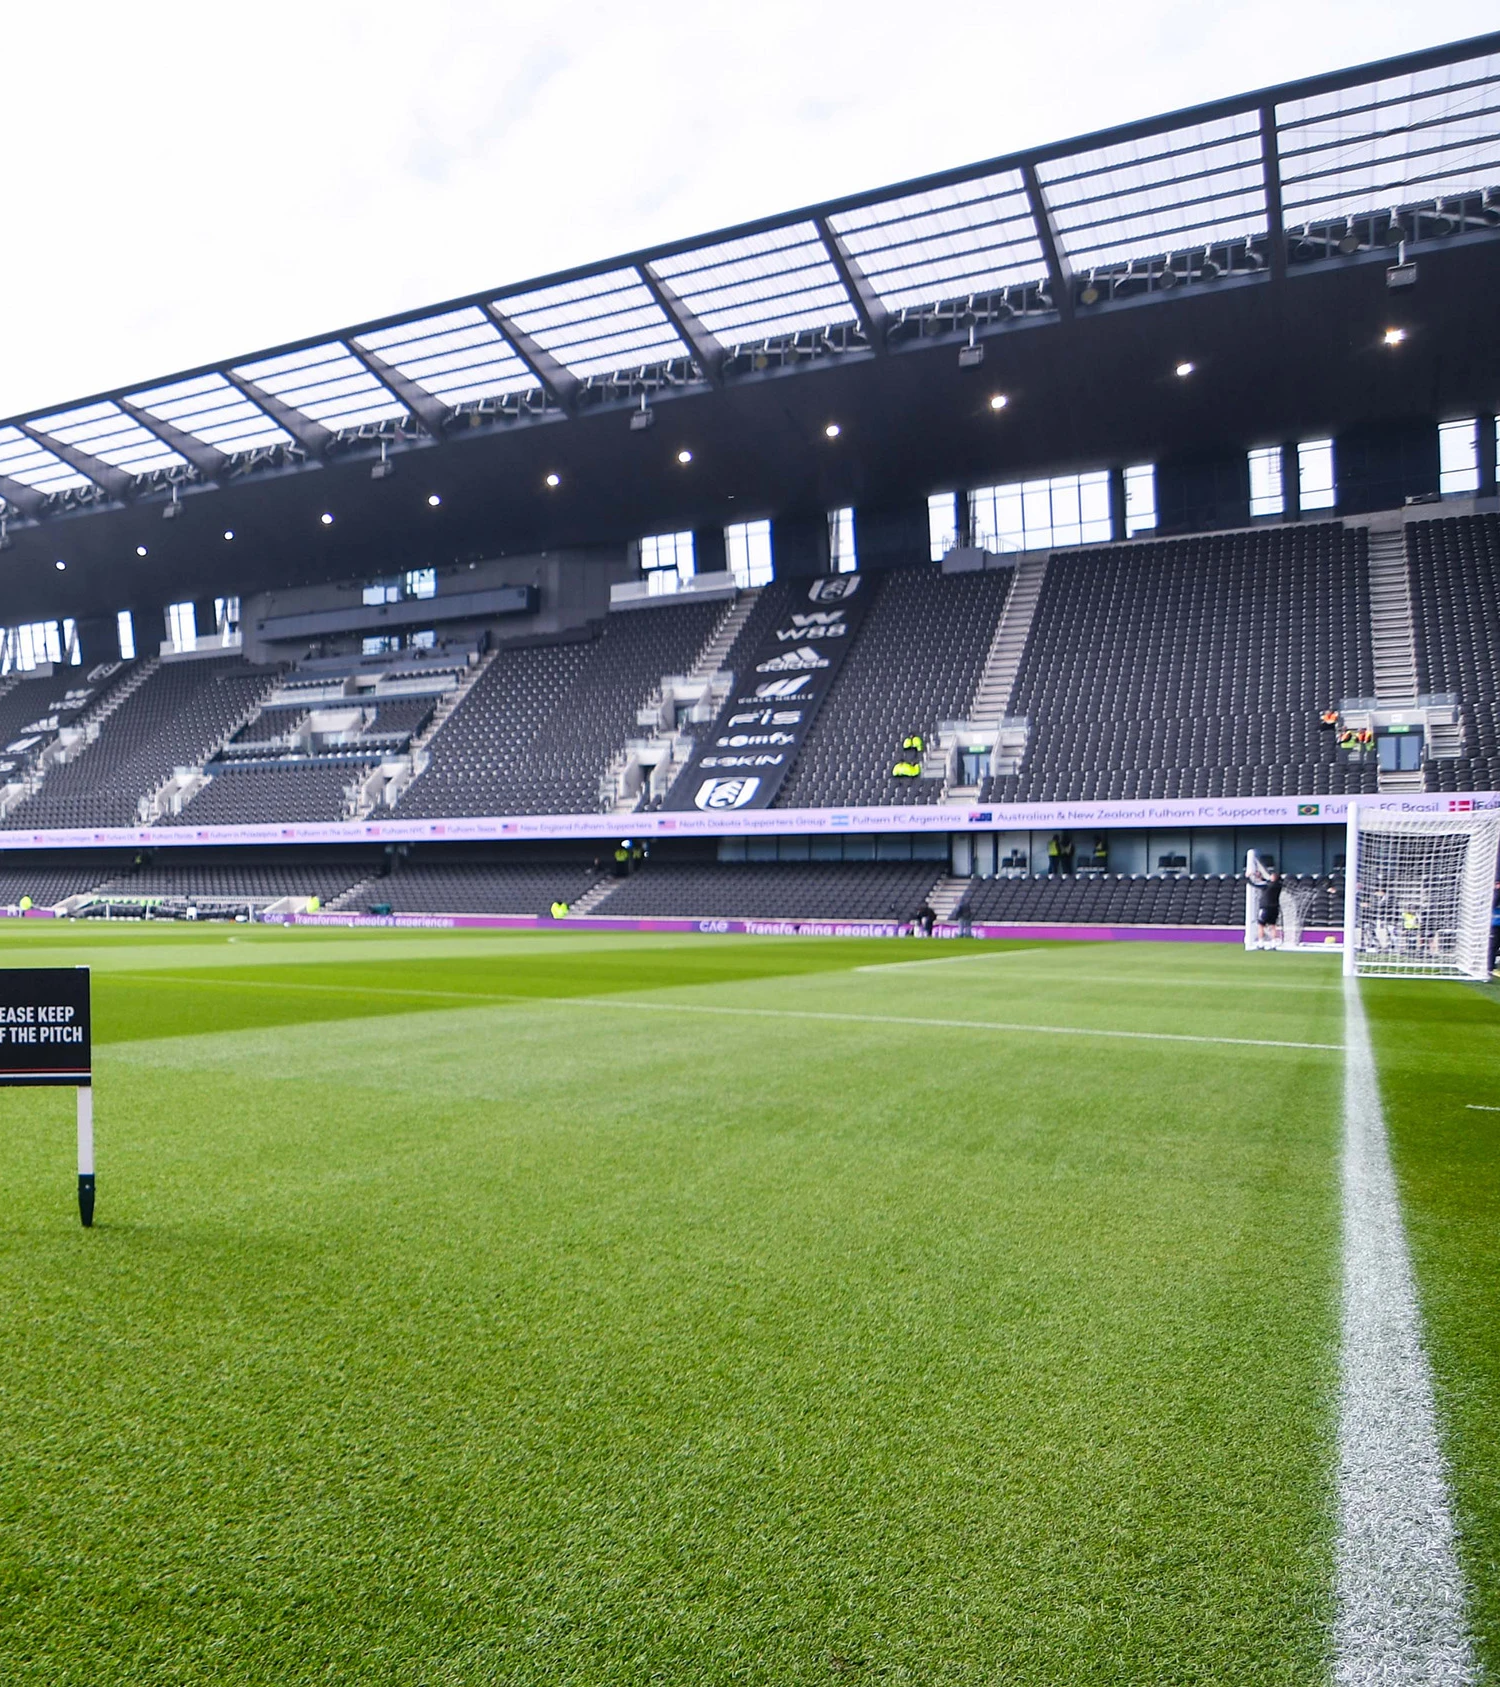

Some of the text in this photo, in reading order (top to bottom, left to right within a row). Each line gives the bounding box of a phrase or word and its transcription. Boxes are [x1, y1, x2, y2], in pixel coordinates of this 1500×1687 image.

[776, 623, 846, 641] W88
[756, 658, 829, 672] adidas
[998, 805, 1288, 821] Australian & New Zealand Fulham FC Supporters
[1402, 801, 1439, 812] Brasil
[679, 816, 827, 828] North Dakota Supporters Group
[852, 814, 961, 825] Fulham FC Argentina
[521, 821, 652, 833] New England Fulham Supporters
[294, 914, 354, 926] Transforming
[37, 1006, 75, 1022] KEEP
[9, 1026, 37, 1043] THE
[40, 1026, 83, 1042] PITCH
